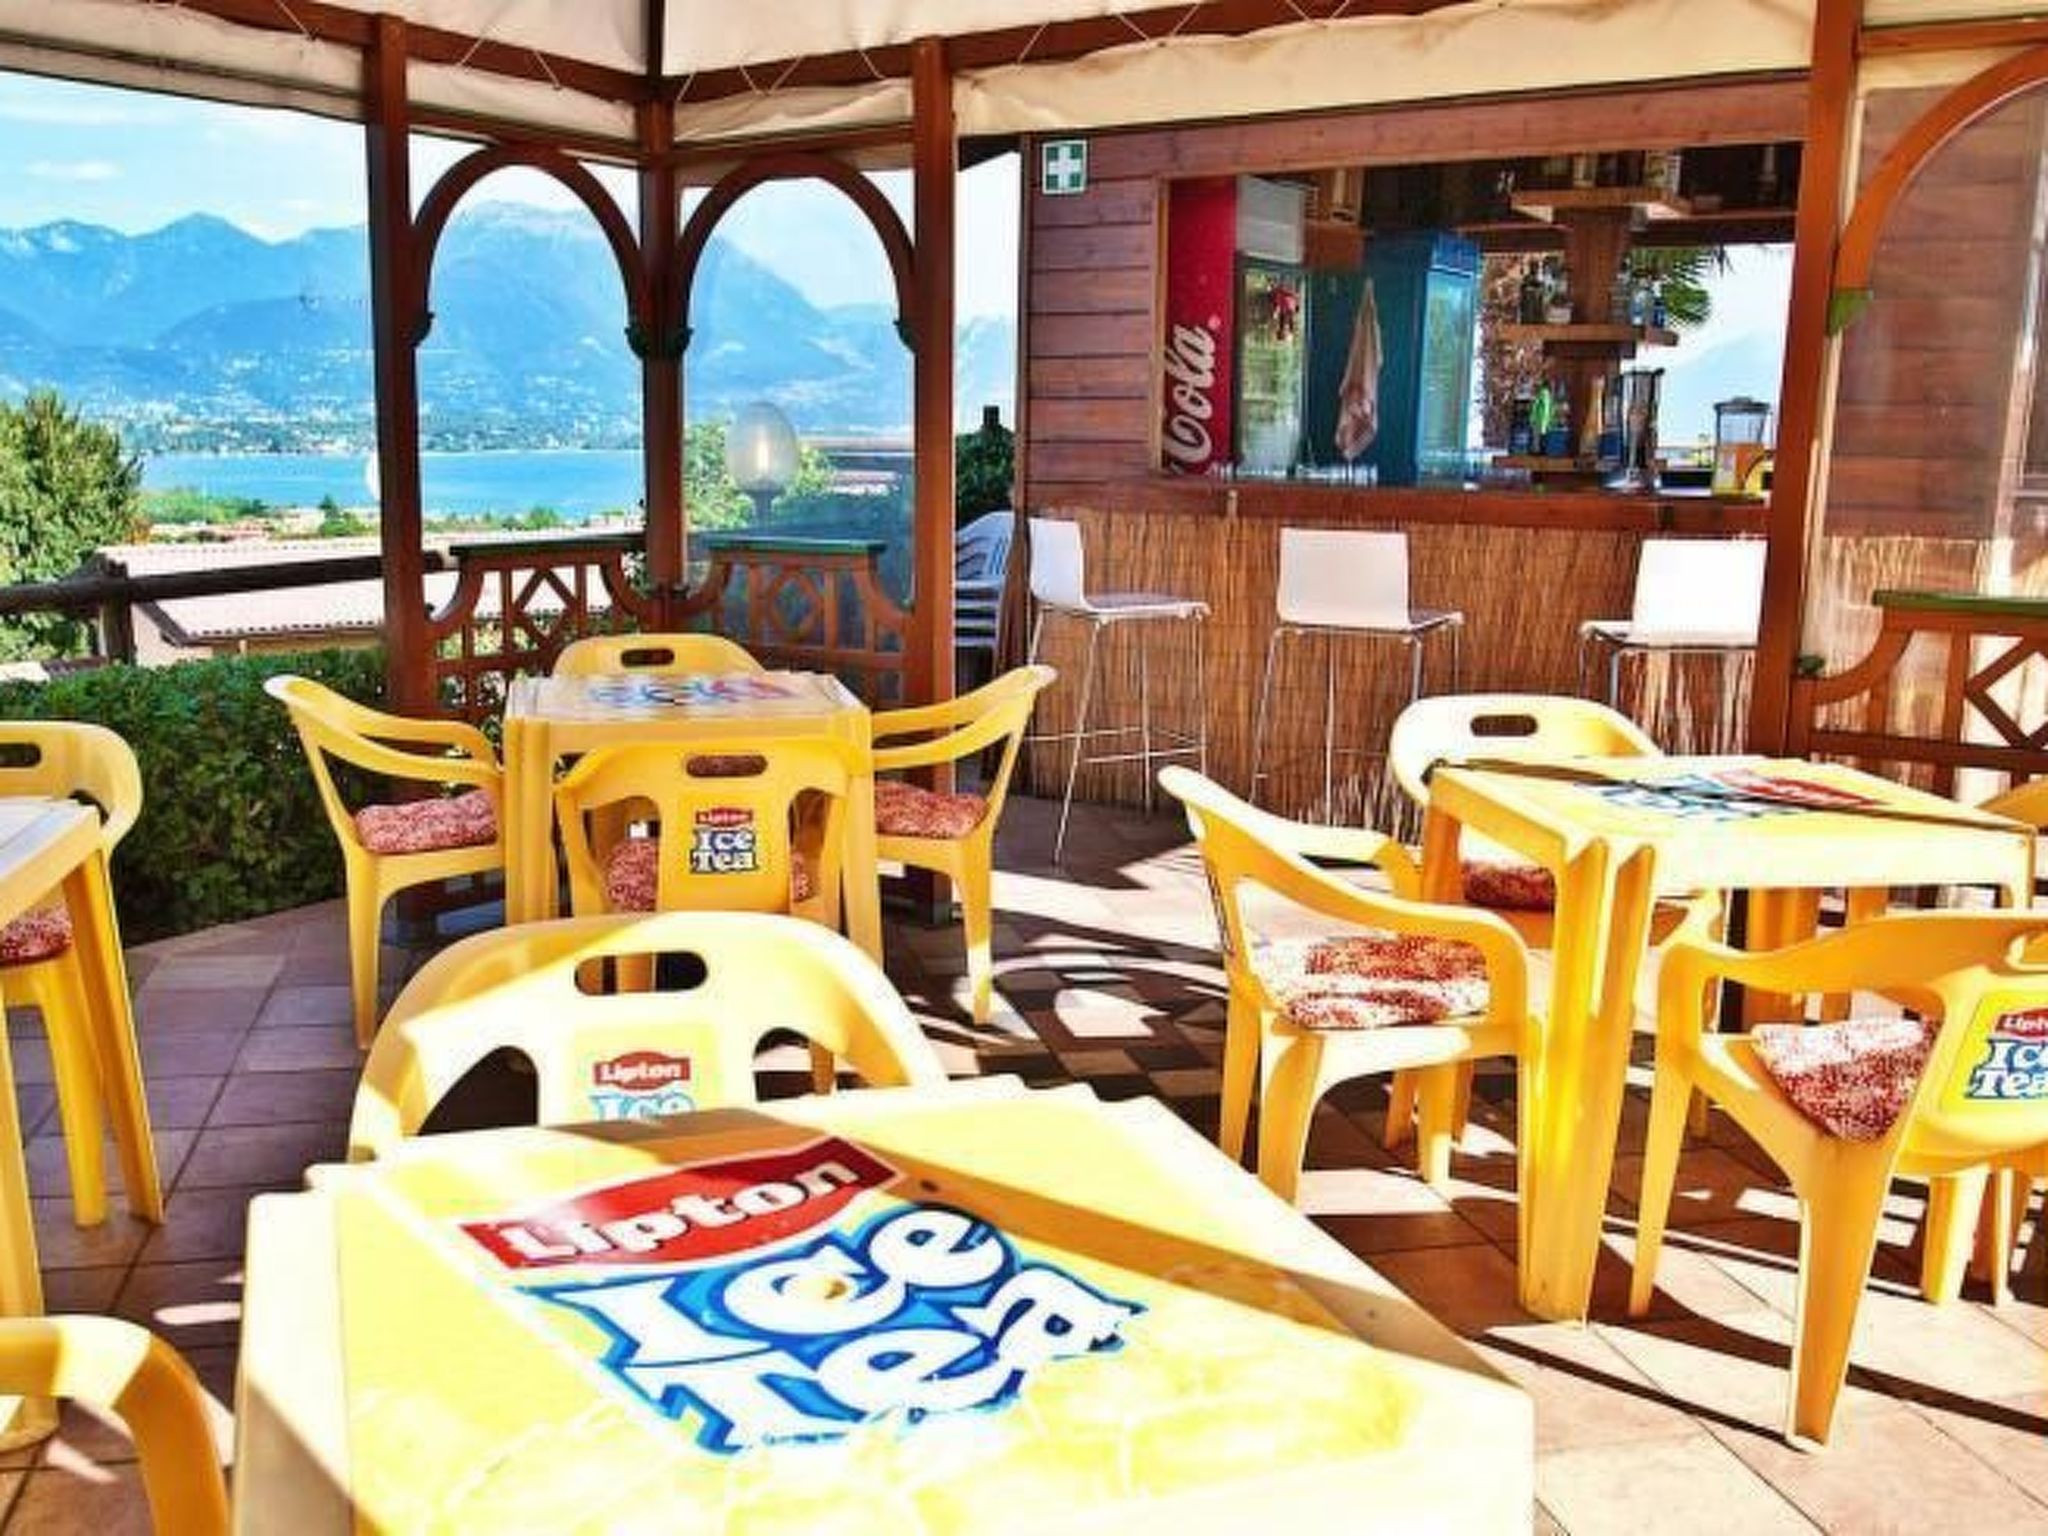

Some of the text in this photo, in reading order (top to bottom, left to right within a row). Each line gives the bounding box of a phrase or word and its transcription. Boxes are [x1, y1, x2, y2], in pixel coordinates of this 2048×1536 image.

[600, 1061, 681, 1085] Lipton
[498, 1160, 860, 1260] Lipton
[540, 1207, 1015, 1366] Ice
[622, 1265, 1138, 1450] Tea
